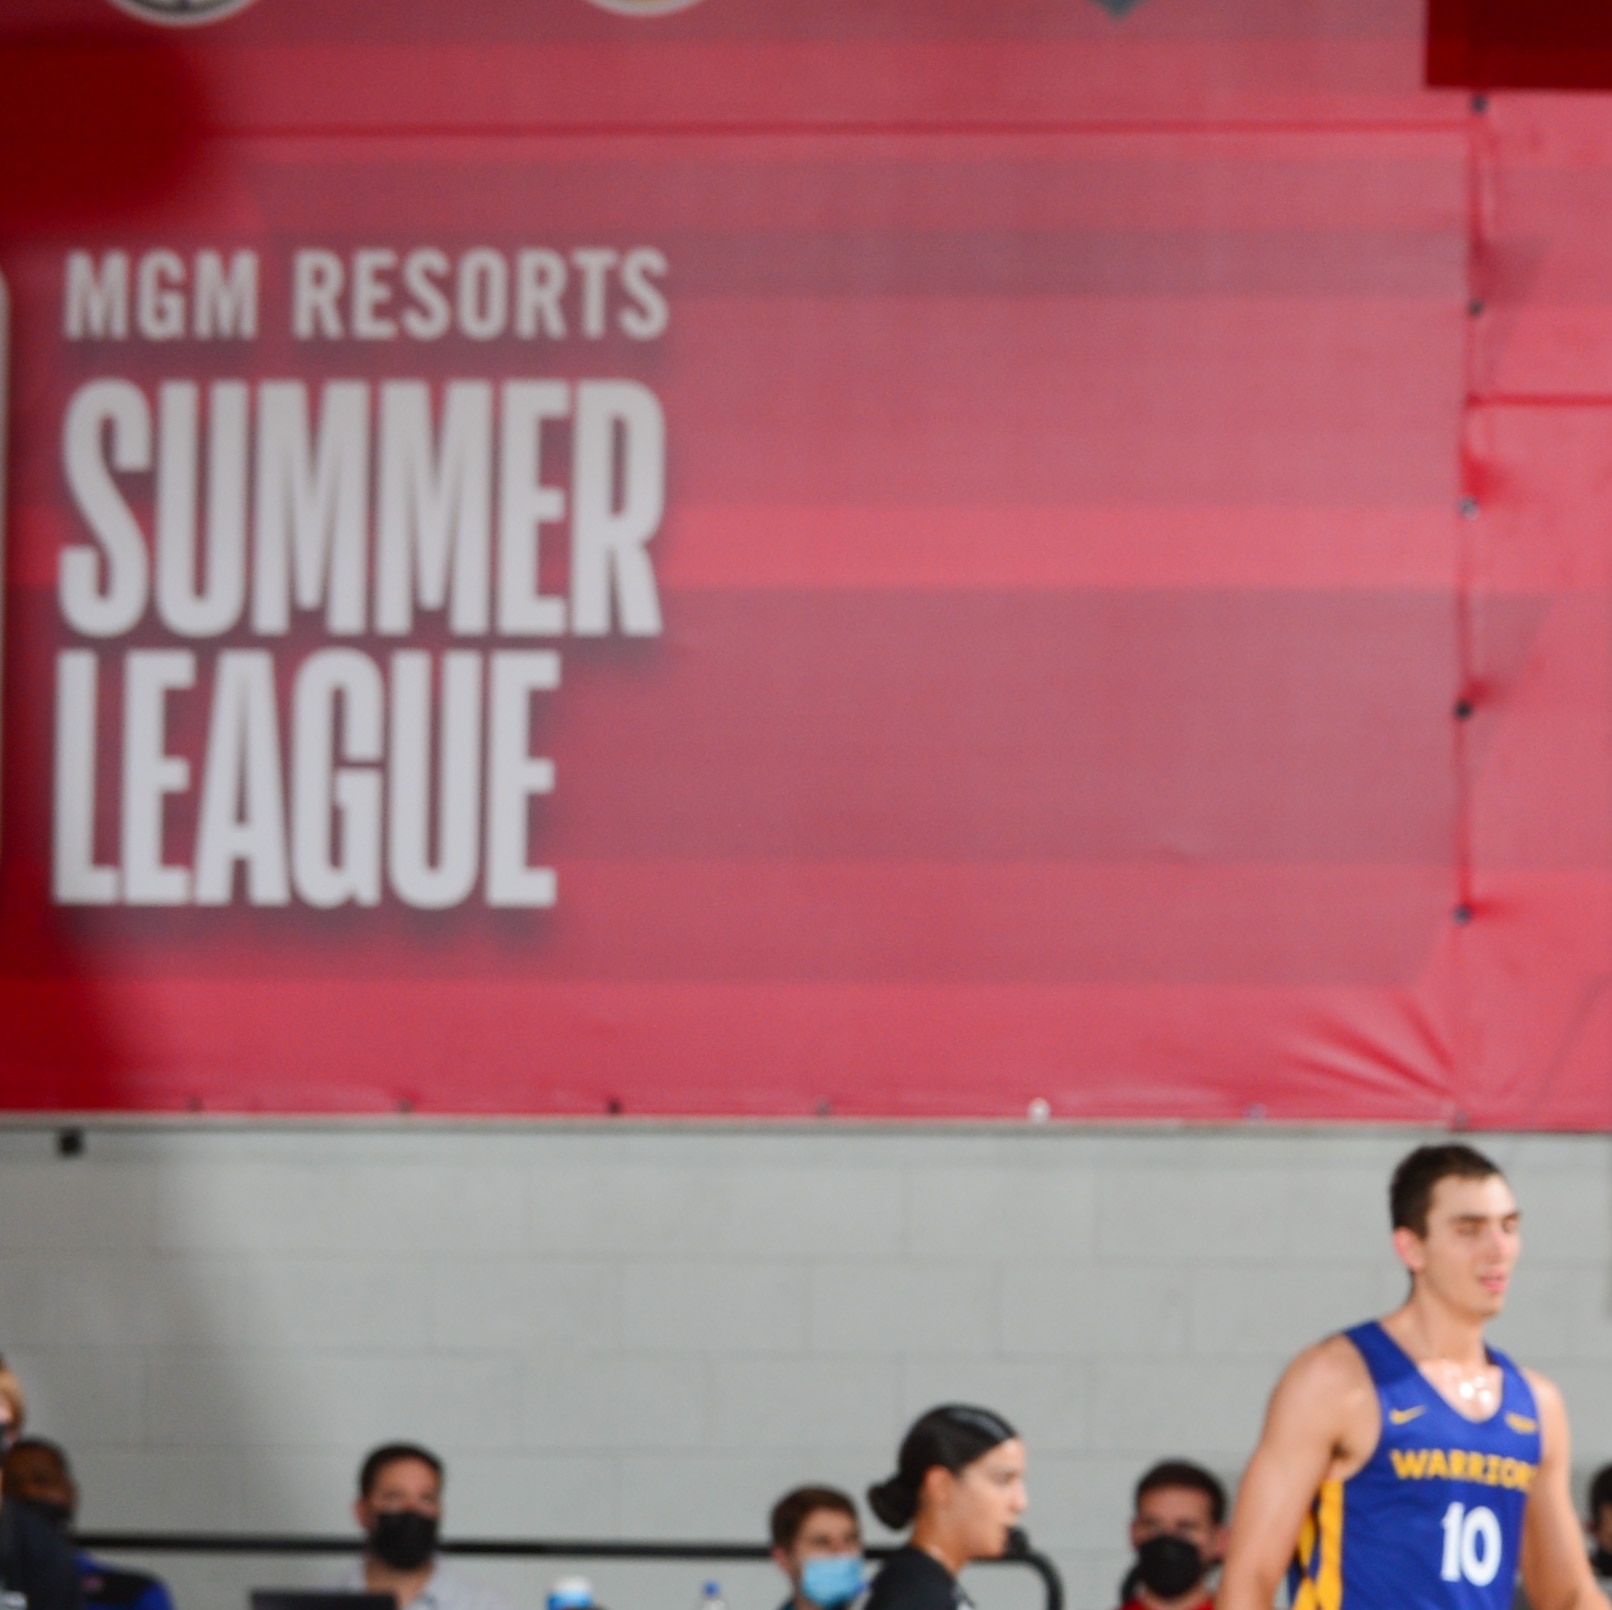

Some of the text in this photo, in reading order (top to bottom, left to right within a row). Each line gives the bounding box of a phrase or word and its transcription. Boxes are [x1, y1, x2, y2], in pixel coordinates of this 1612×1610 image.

[62, 248, 671, 343] MGM RESORTS
[57, 378, 667, 638] SUMMER
[51, 648, 561, 910] LEAGUE
[1389, 1448, 1537, 1492] WARRIOR
[1440, 1501, 1502, 1587] 10
